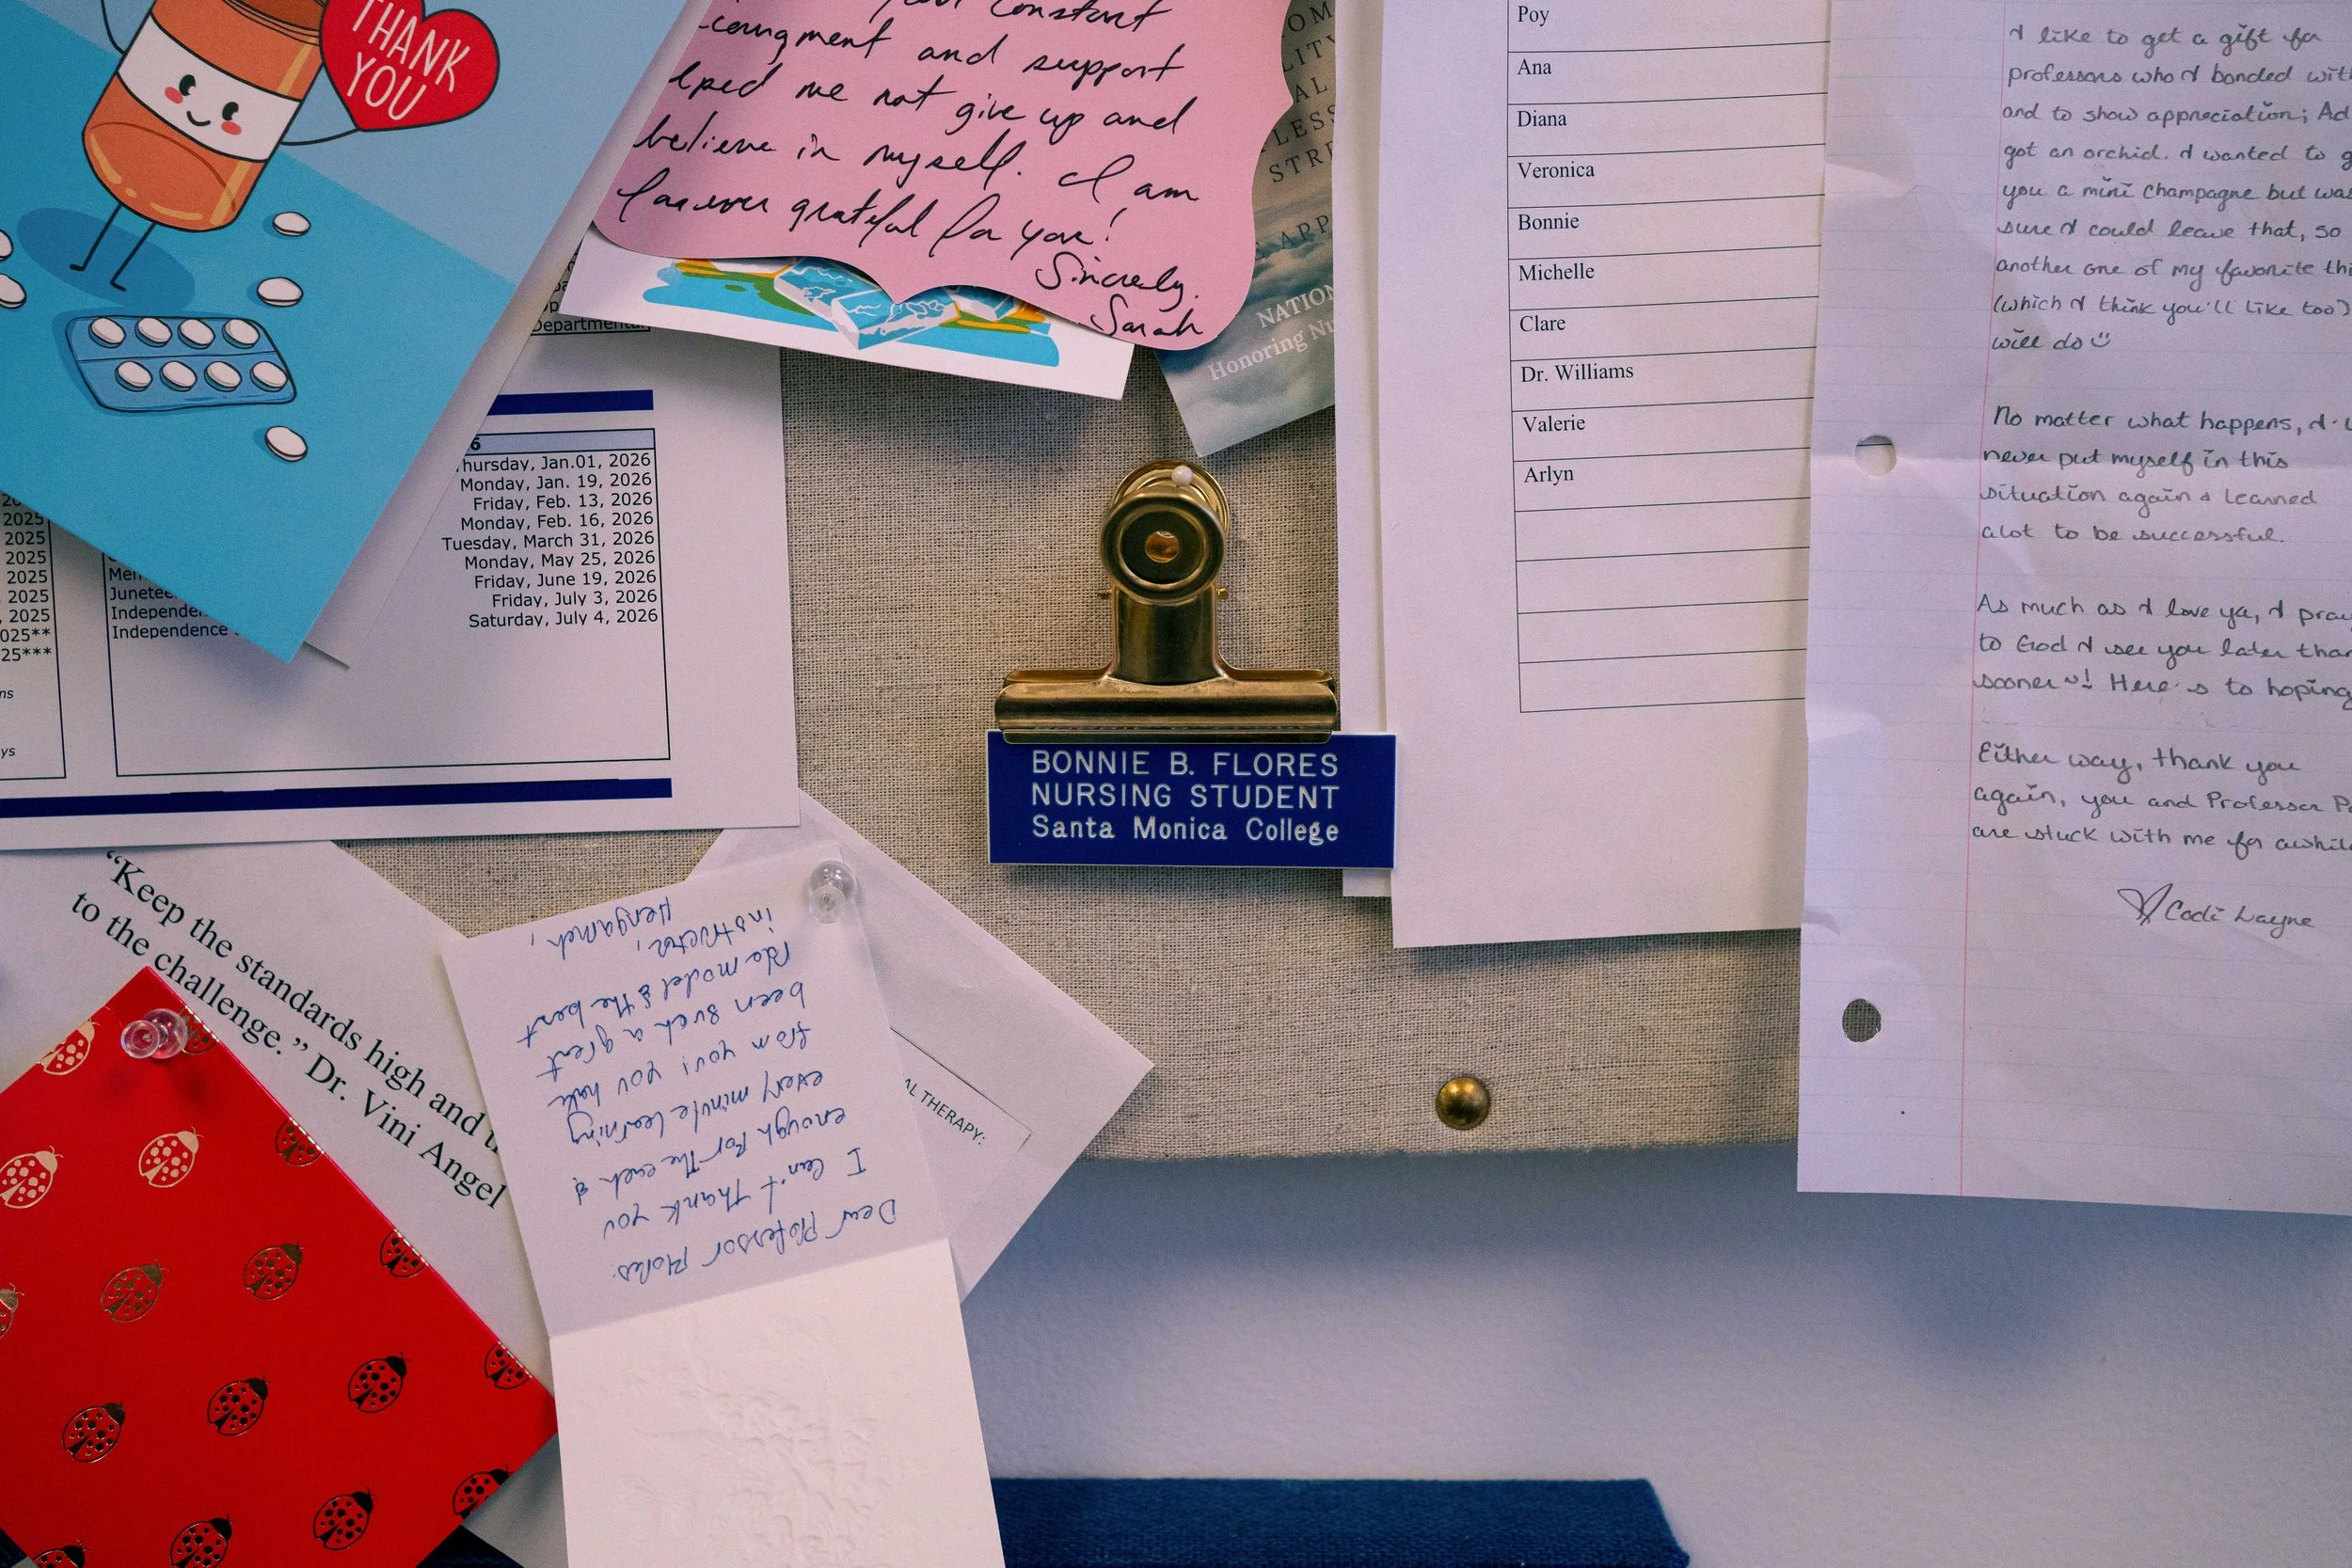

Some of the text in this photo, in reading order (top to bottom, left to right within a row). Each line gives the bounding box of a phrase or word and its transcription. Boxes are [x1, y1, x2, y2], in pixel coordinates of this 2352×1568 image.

[1518, 6, 1549, 26] Poy
[2038, 28, 2091, 43] like
[2107, 29, 2128, 45] to
[2142, 28, 2182, 58] get
[2192, 33, 2208, 45] a
[2220, 24, 2272, 56] gift
[917, 34, 1185, 91] and support
[1518, 58, 1551, 74] Ana
[346, 52, 427, 120] YOU
[795, 74, 1199, 146] me not give up and
[1518, 111, 1566, 127] Diana
[2003, 104, 2042, 120] and
[2052, 107, 2072, 121] to
[2083, 105, 2138, 122] show
[797, 134, 840, 161] in
[863, 128, 1026, 191] myself.
[1133, 182, 1200, 201] am
[2004, 142, 2037, 168] got
[2049, 147, 2074, 157] an
[2202, 145, 2288, 162] wanted
[2305, 147, 2326, 161] to
[1518, 162, 1595, 178] Veronica
[1518, 214, 1579, 230] Bonnie
[1519, 263, 1595, 281] Michelle
[1995, 256, 2314, 292] another one of my favorite
[1520, 315, 1565, 331] Clare
[1208, 330, 1308, 380] Honoring
[1521, 363, 1633, 383] Dr. Williams
[1523, 415, 1585, 432] Valerie
[1994, 405, 2301, 436] No matter what happens,
[541, 454, 602, 470] Jan.01,
[609, 452, 651, 467] 2026
[460, 472, 652, 492] Monday, Jan. 19, 2026
[1524, 467, 1573, 485] Arlyn
[473, 492, 653, 512] Friday, Feb. 13, 2026
[461, 512, 654, 531] Monday, Feb. 16, 2026
[5, 531, 46, 546] 2025
[442, 531, 655, 551] Tuesday, March 31, 2026
[6, 550, 46, 564] 2025
[465, 550, 655, 570] Monday, May 25, 2026
[7, 569, 47, 584] 2025
[475, 570, 657, 589] Friday, June 19, 2026
[8, 589, 49, 603] 2025
[493, 589, 658, 609] Friday, July 3, 2026
[9, 609, 50, 623] 2025
[469, 609, 658, 627] Saturday, July 4, 2026
[113, 624, 228, 640] Independence
[1032, 750, 1339, 777] BONNIE B. FLORES
[1979, 741, 2060, 765] Either
[2153, 748, 2235, 770] thank
[2246, 761, 2302, 785] you
[1032, 782, 1340, 810] NURSING STUDENT
[1032, 814, 1339, 846] Santa Monica College
[735, 980, 805, 1015] been
[189, 916, 233, 958] the
[235, 954, 363, 1052] standards
[363, 1039, 427, 1099] high
[429, 1088, 485, 1138] and
[72, 890, 101, 923] to
[104, 914, 150, 957] the
[305, 1053, 345, 1101] Dr.
[361, 1088, 421, 1148] Vini
[419, 1140, 508, 1210] Angel
[920, 1090, 985, 1145] THERAPY:
